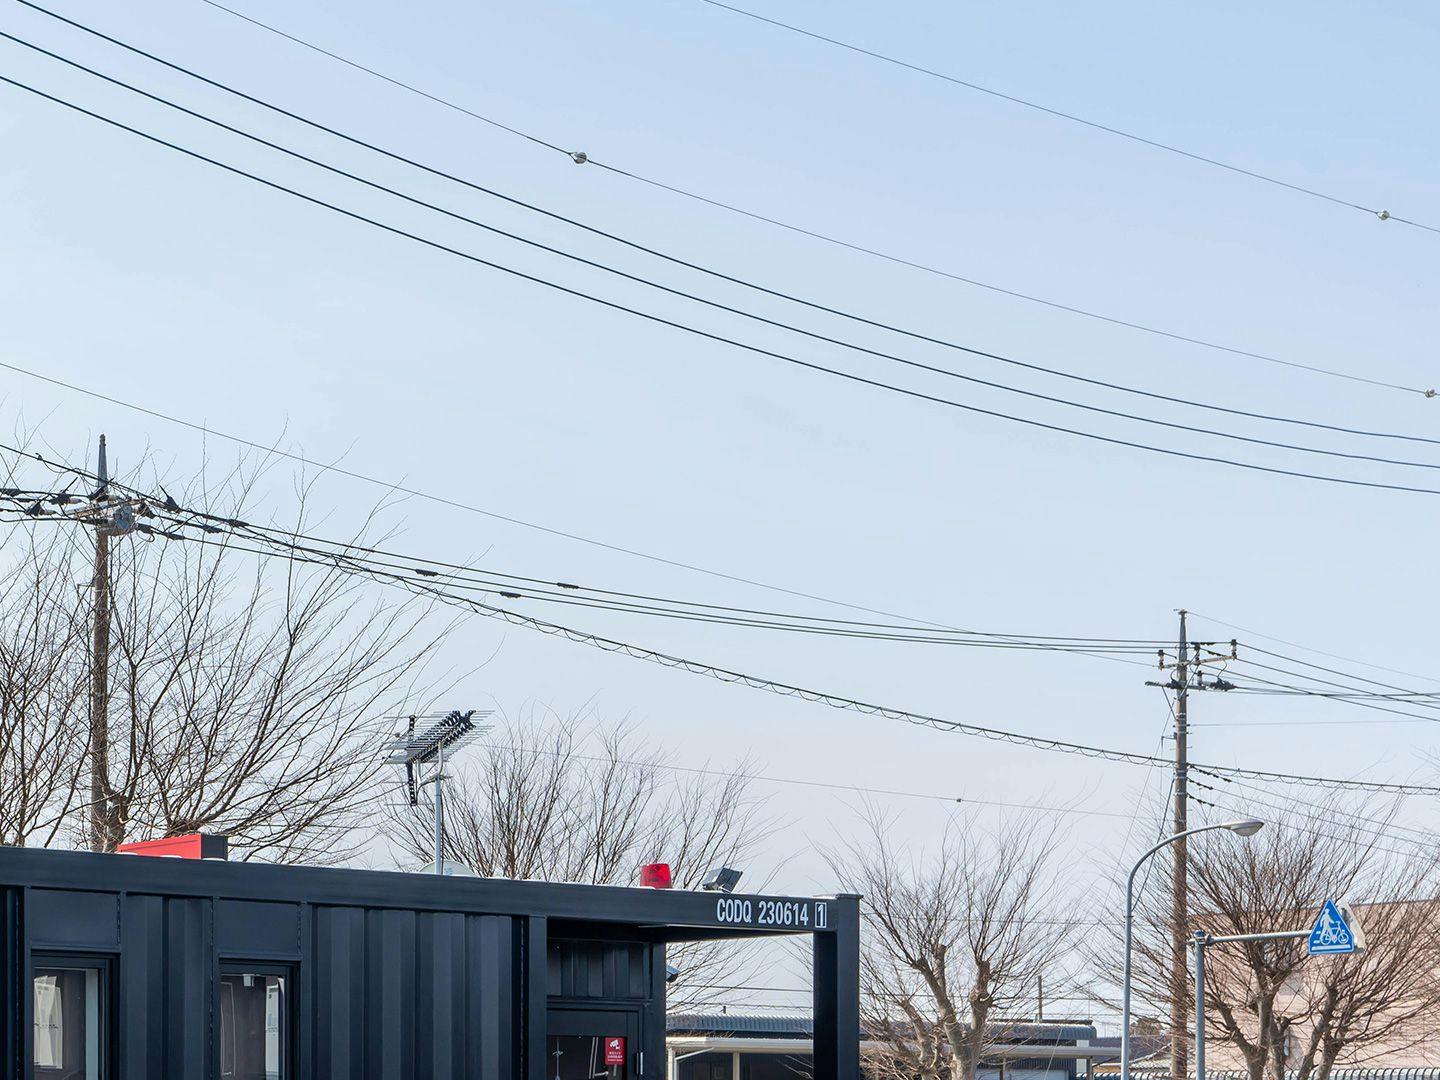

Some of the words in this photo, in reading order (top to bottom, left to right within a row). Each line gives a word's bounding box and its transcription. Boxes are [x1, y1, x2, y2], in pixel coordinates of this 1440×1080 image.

[716, 898, 752, 924] CODQ
[758, 901, 809, 926] 230614
[815, 902, 827, 928] 1
